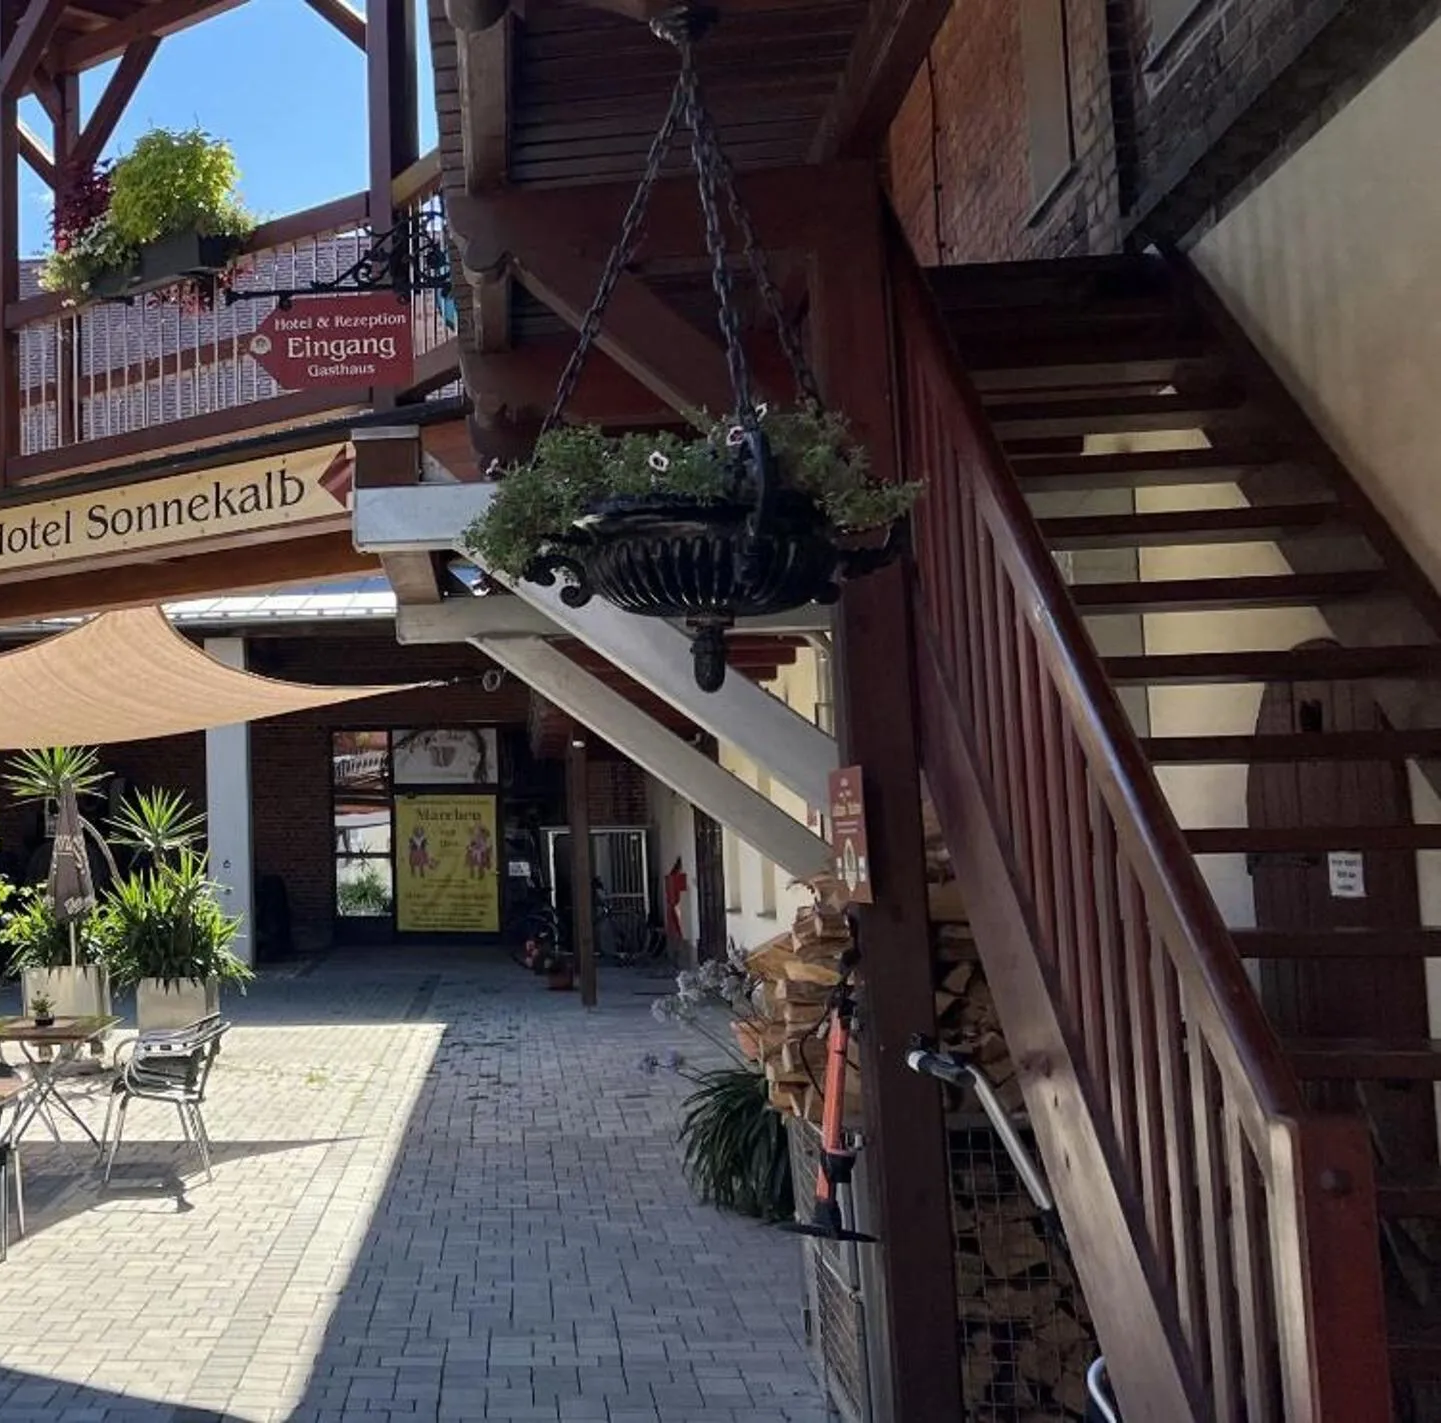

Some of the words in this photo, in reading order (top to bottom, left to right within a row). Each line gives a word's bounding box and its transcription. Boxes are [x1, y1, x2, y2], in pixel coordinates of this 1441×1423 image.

[274, 315, 312, 332] Hotel
[317, 315, 331, 329] &
[334, 313, 407, 329] Rezeption
[287, 336, 396, 361] Eingang
[307, 362, 376, 378] Gasthaus
[85, 467, 306, 541] Sonnekalb
